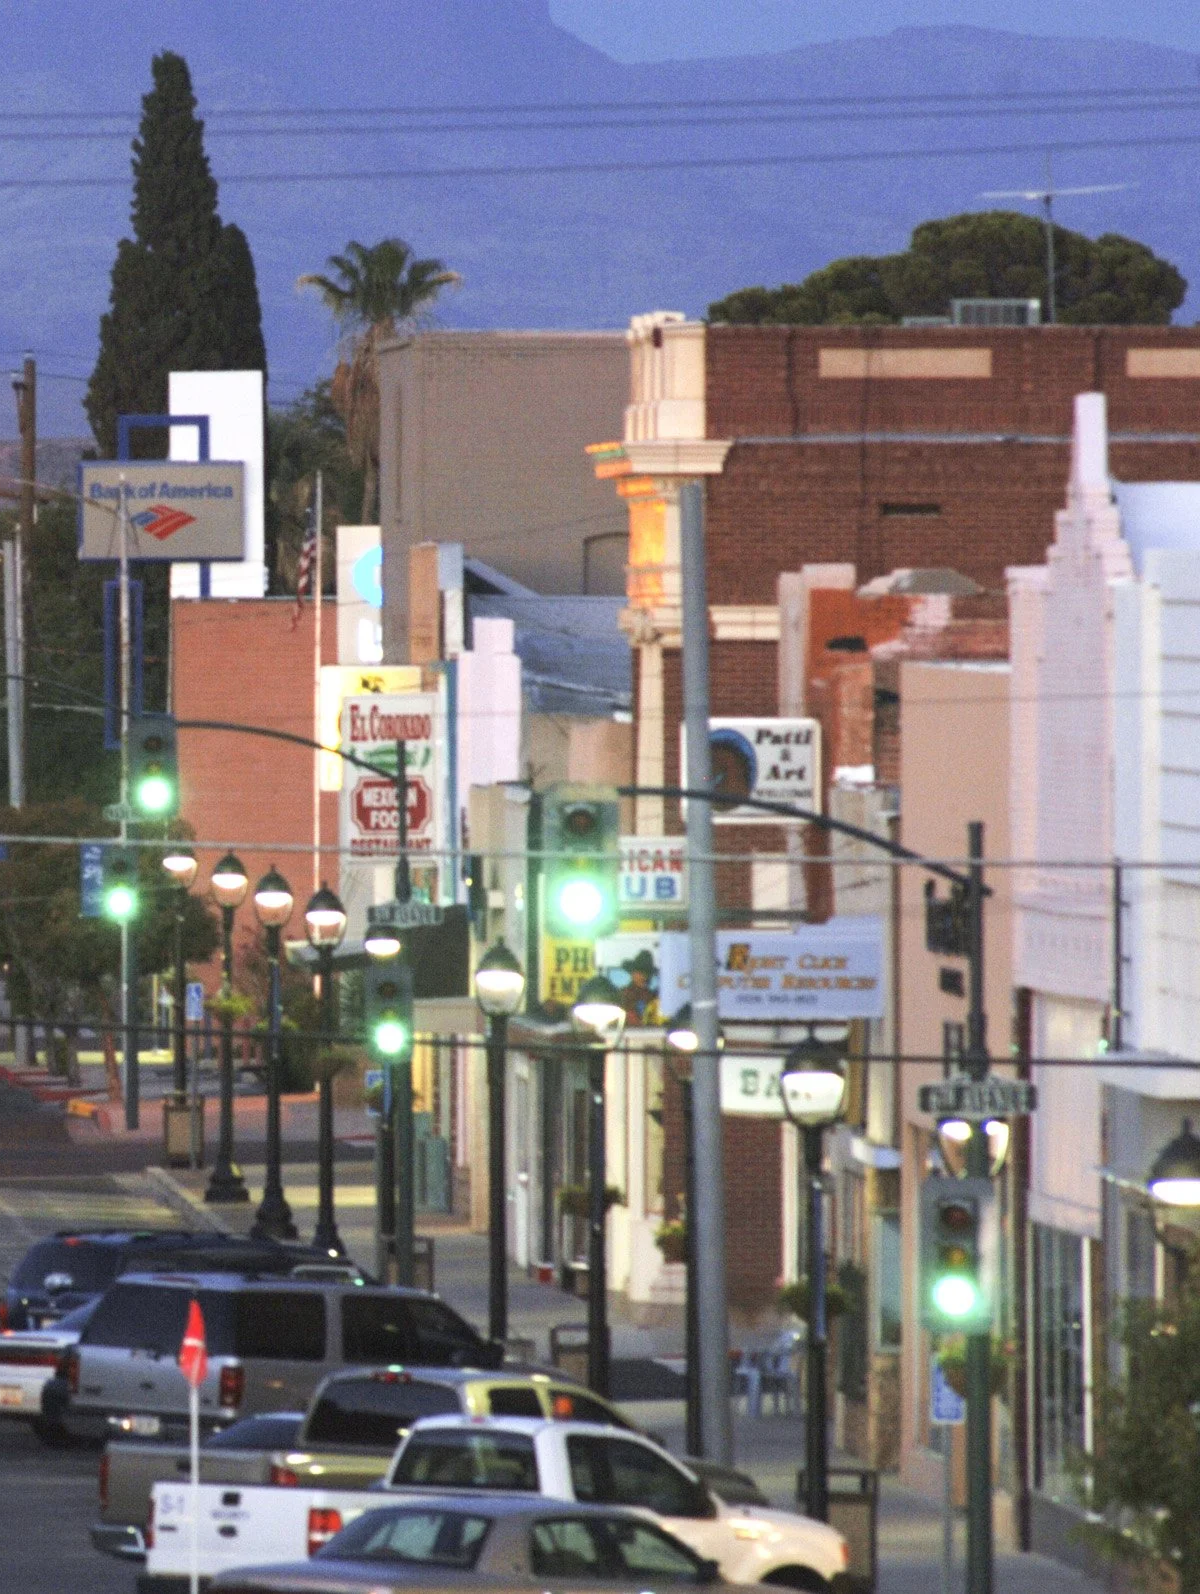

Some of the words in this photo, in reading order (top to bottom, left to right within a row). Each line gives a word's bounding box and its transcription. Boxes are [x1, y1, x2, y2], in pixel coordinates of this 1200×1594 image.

[90, 482, 135, 498] Bank
[137, 481, 156, 498] of
[160, 481, 234, 498] America
[756, 728, 813, 745] Patti
[766, 764, 806, 780] Art
